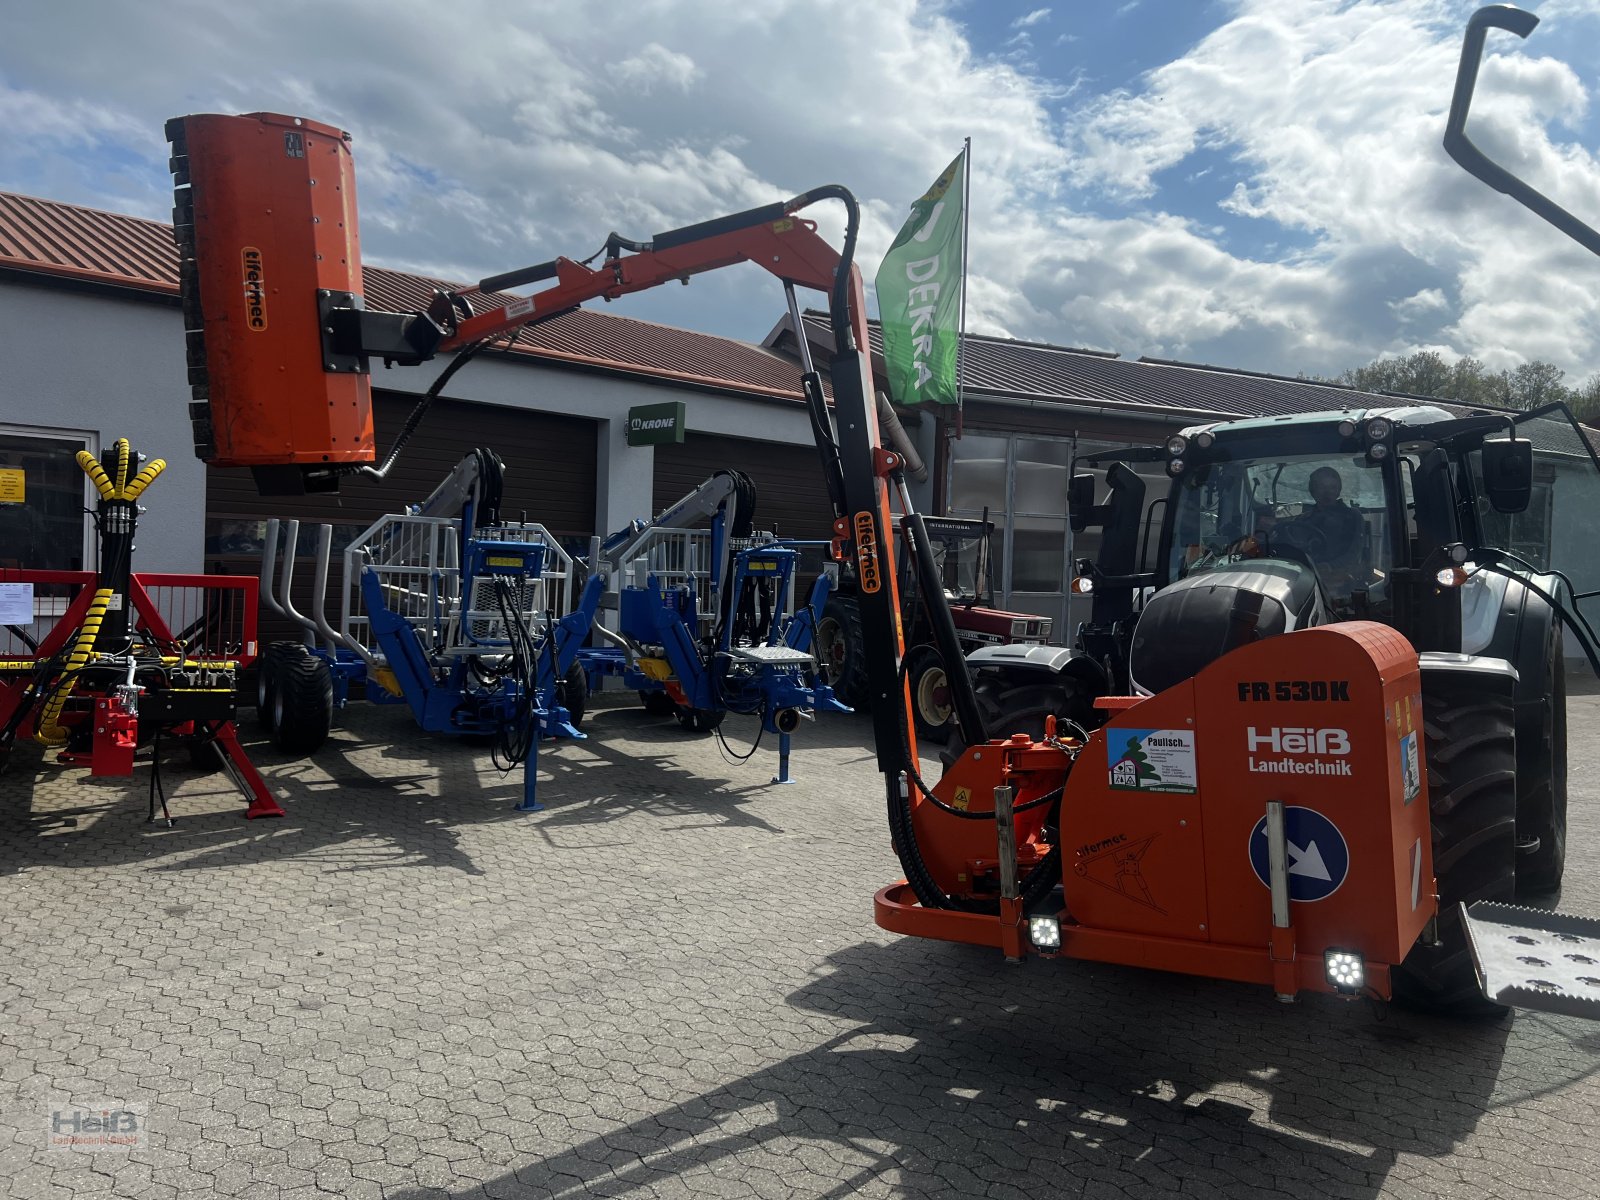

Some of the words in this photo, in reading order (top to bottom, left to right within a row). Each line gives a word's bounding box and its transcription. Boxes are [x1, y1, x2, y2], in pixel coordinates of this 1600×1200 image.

[906, 254, 941, 391] DEKRA
[641, 417, 675, 430] KRONE
[859, 515, 878, 589] tifermec
[1238, 681, 1271, 702] FR
[1147, 737, 1183, 748] Paulisch
[1247, 726, 1351, 755] Heiß
[1248, 756, 1352, 776] Landtechnik
